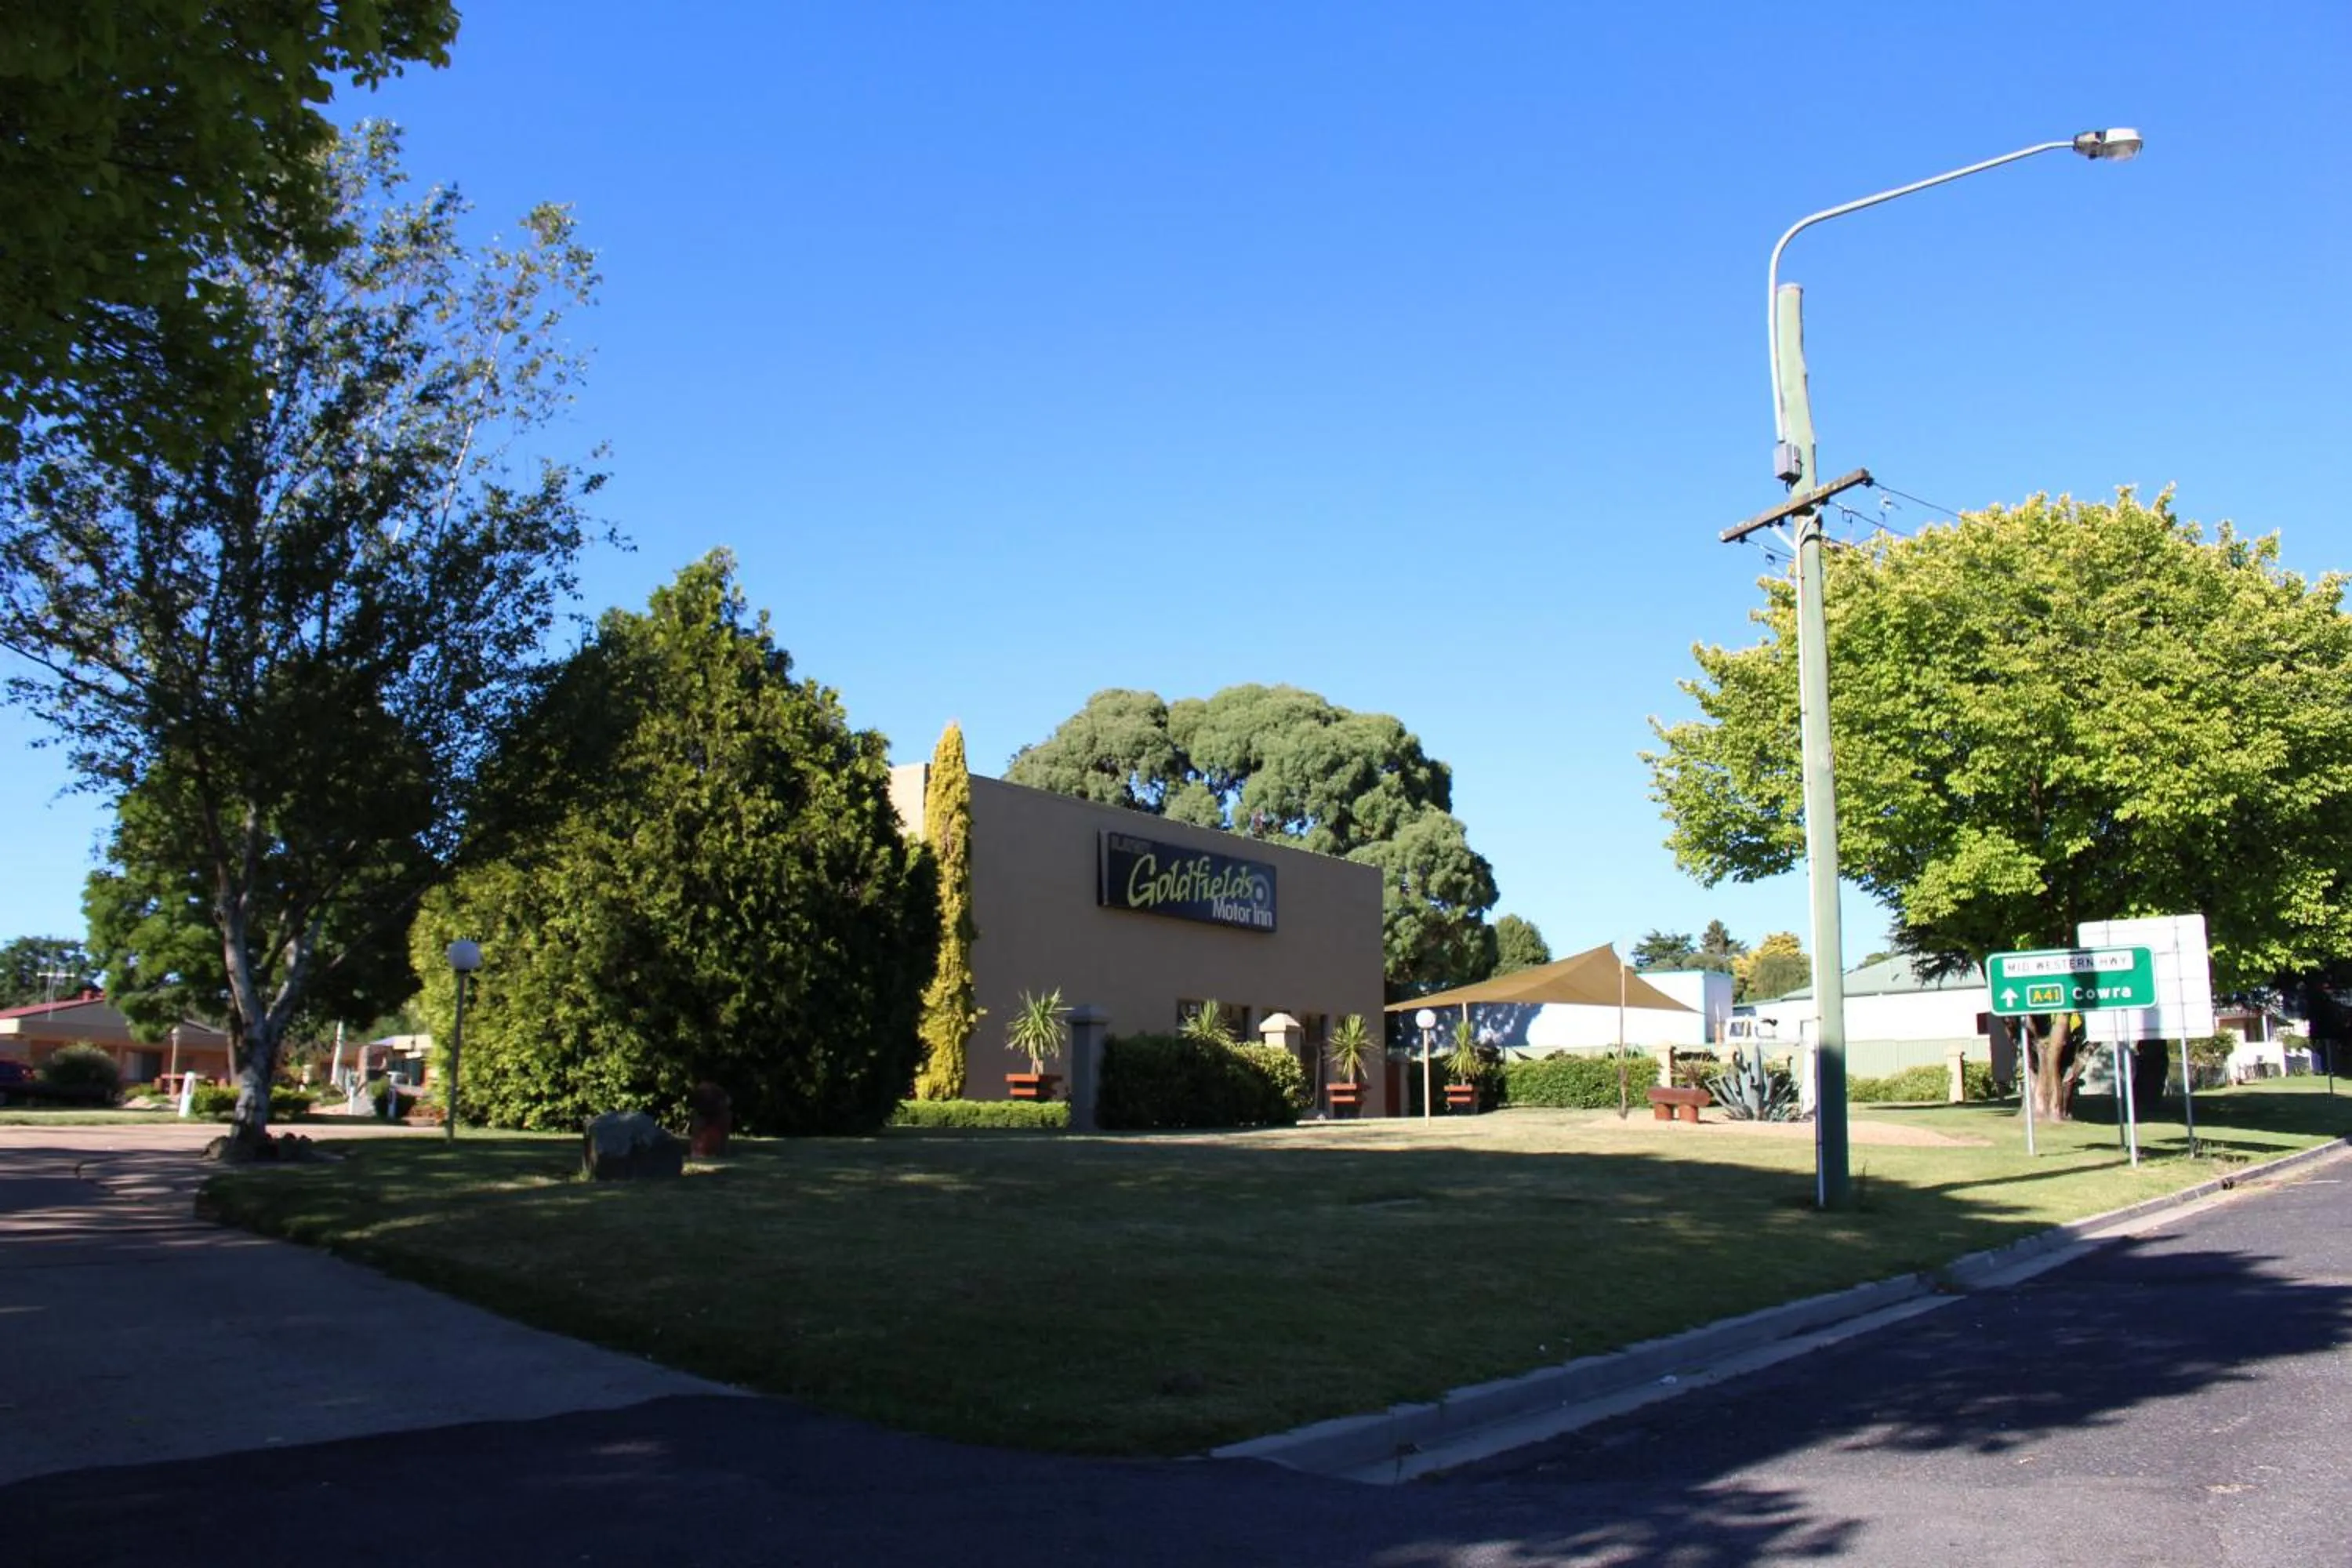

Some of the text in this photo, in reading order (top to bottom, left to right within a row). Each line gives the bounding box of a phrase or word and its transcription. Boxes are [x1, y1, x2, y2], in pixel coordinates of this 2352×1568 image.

[1127, 853, 1254, 908] Goldfields
[1212, 897, 1273, 927] Motor Inn
[2007, 956, 2127, 972] MID WESTERN HWY
[2032, 985, 2132, 1003] A41 Cowra
